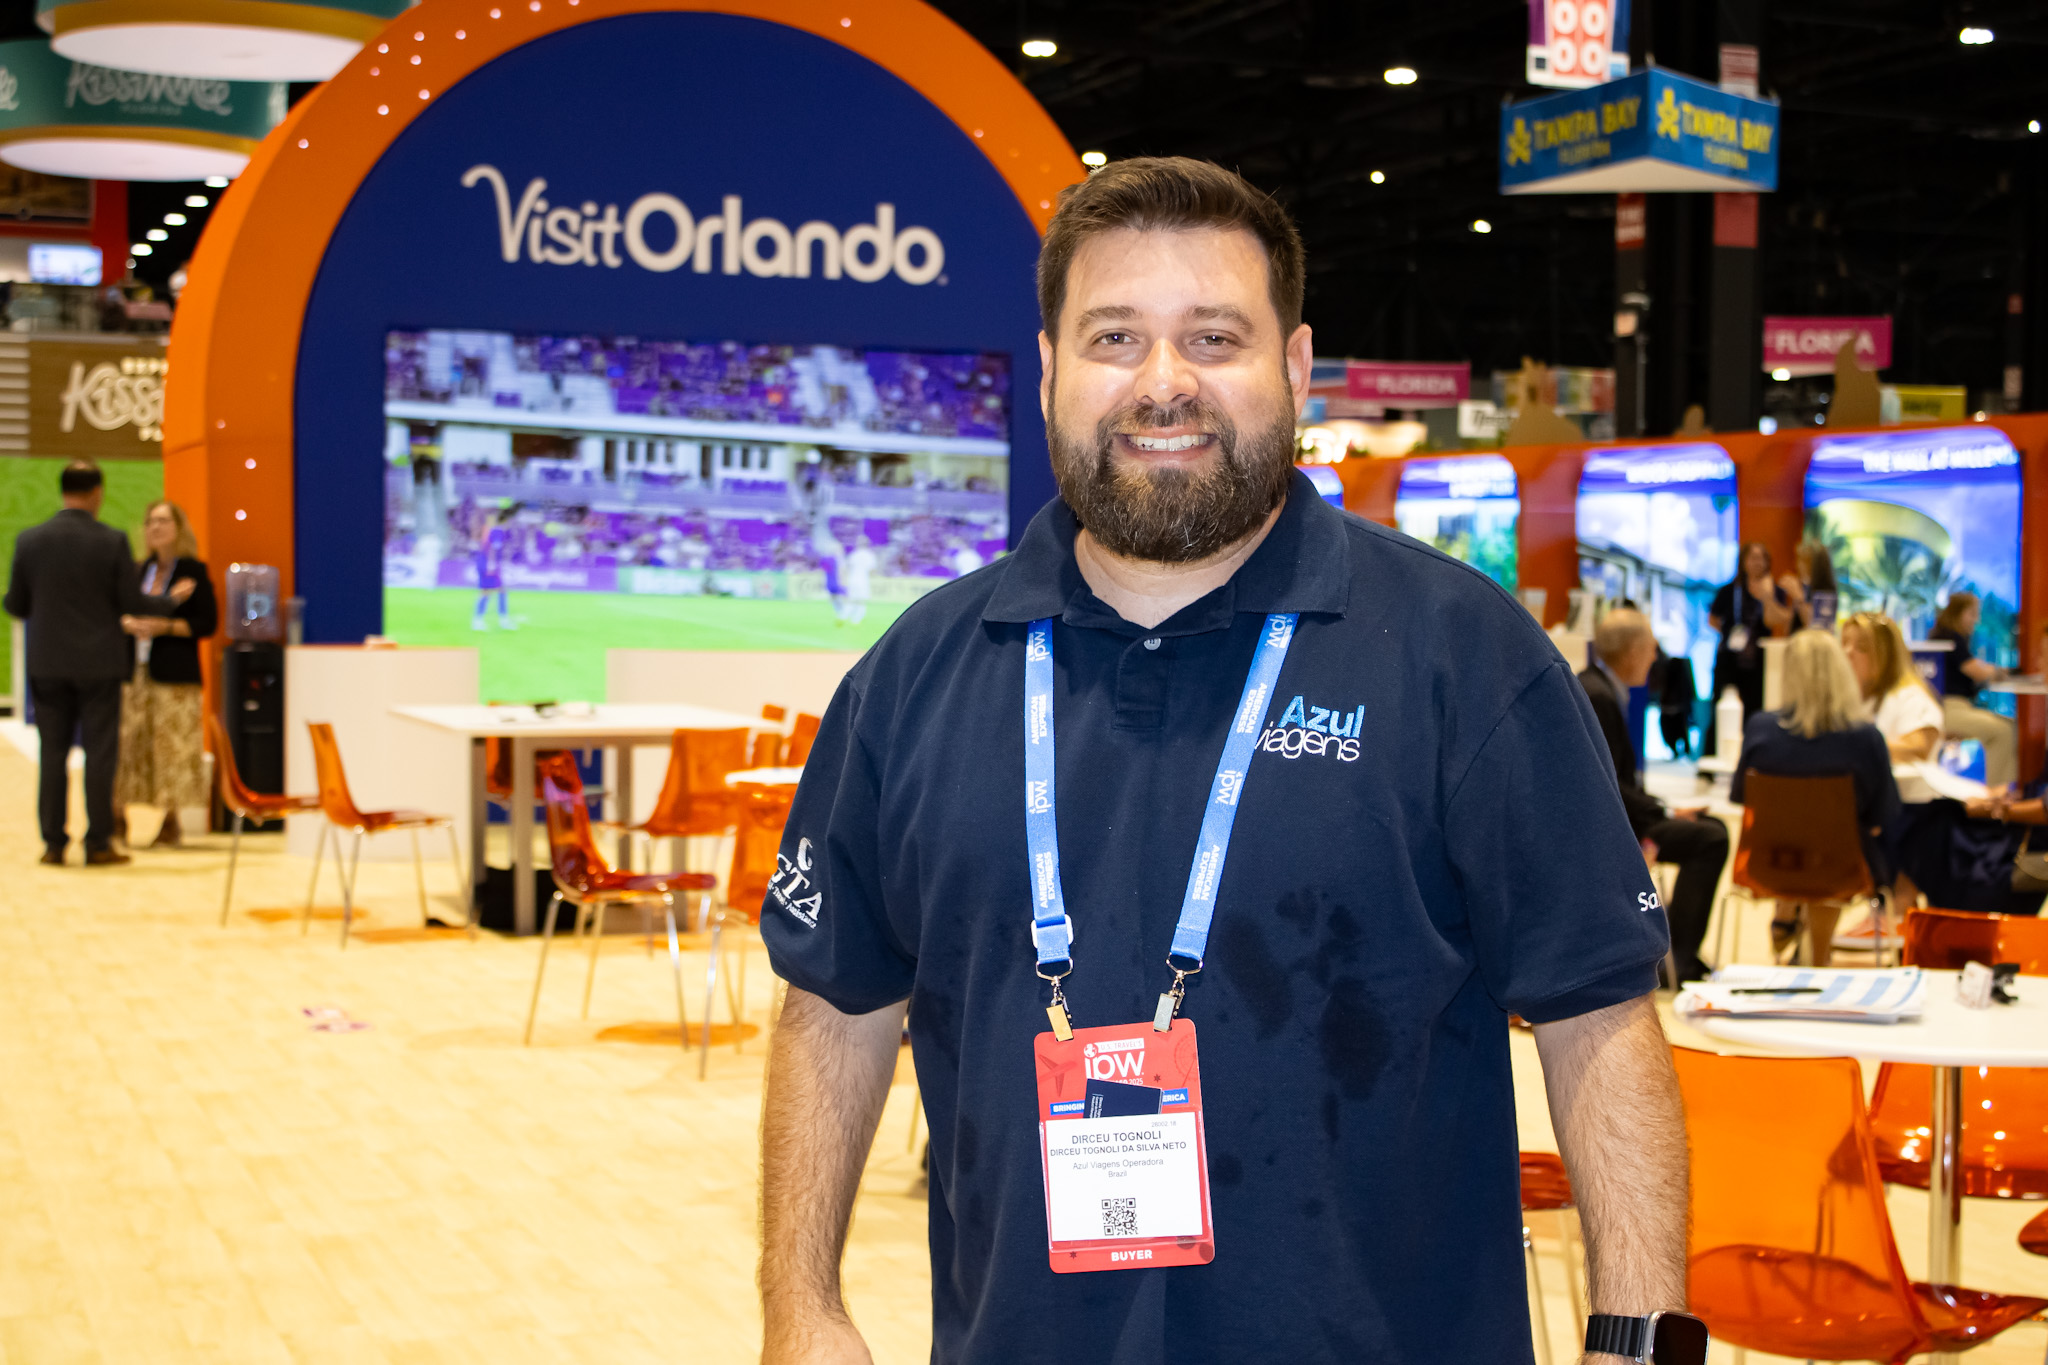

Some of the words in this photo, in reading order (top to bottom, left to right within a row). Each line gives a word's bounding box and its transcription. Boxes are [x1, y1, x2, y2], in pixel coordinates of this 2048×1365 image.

[1030, 695, 1039, 745] AMERICAN
[1038, 694, 1047, 737] EXPRESS
[1237, 689, 1257, 733] EXPRESS
[1245, 683, 1267, 733] AMERICAN
[1278, 695, 1365, 738] Azul
[1035, 853, 1048, 908] AMERICAN
[1044, 852, 1055, 900] EXPRESS
[1192, 852, 1210, 900] EXPRESS
[1201, 844, 1220, 900] AMERICAN
[1050, 1147, 1081, 1156] DIRCEU
[1083, 1145, 1119, 1155] TOGNOLI
[1122, 1145, 1134, 1153] DA
[1136, 1143, 1160, 1152] SILVA
[1162, 1141, 1187, 1150] NETO
[1072, 1133, 1110, 1144] DIRCEU
[1113, 1130, 1162, 1142] TOGNOLI
[1073, 1162, 1088, 1170] Azul
[1090, 1160, 1120, 1171] Viagens
[1122, 1157, 1164, 1168] Operadora
[1108, 1170, 1127, 1178] Brazil
[1111, 1250, 1153, 1262] BUYER
